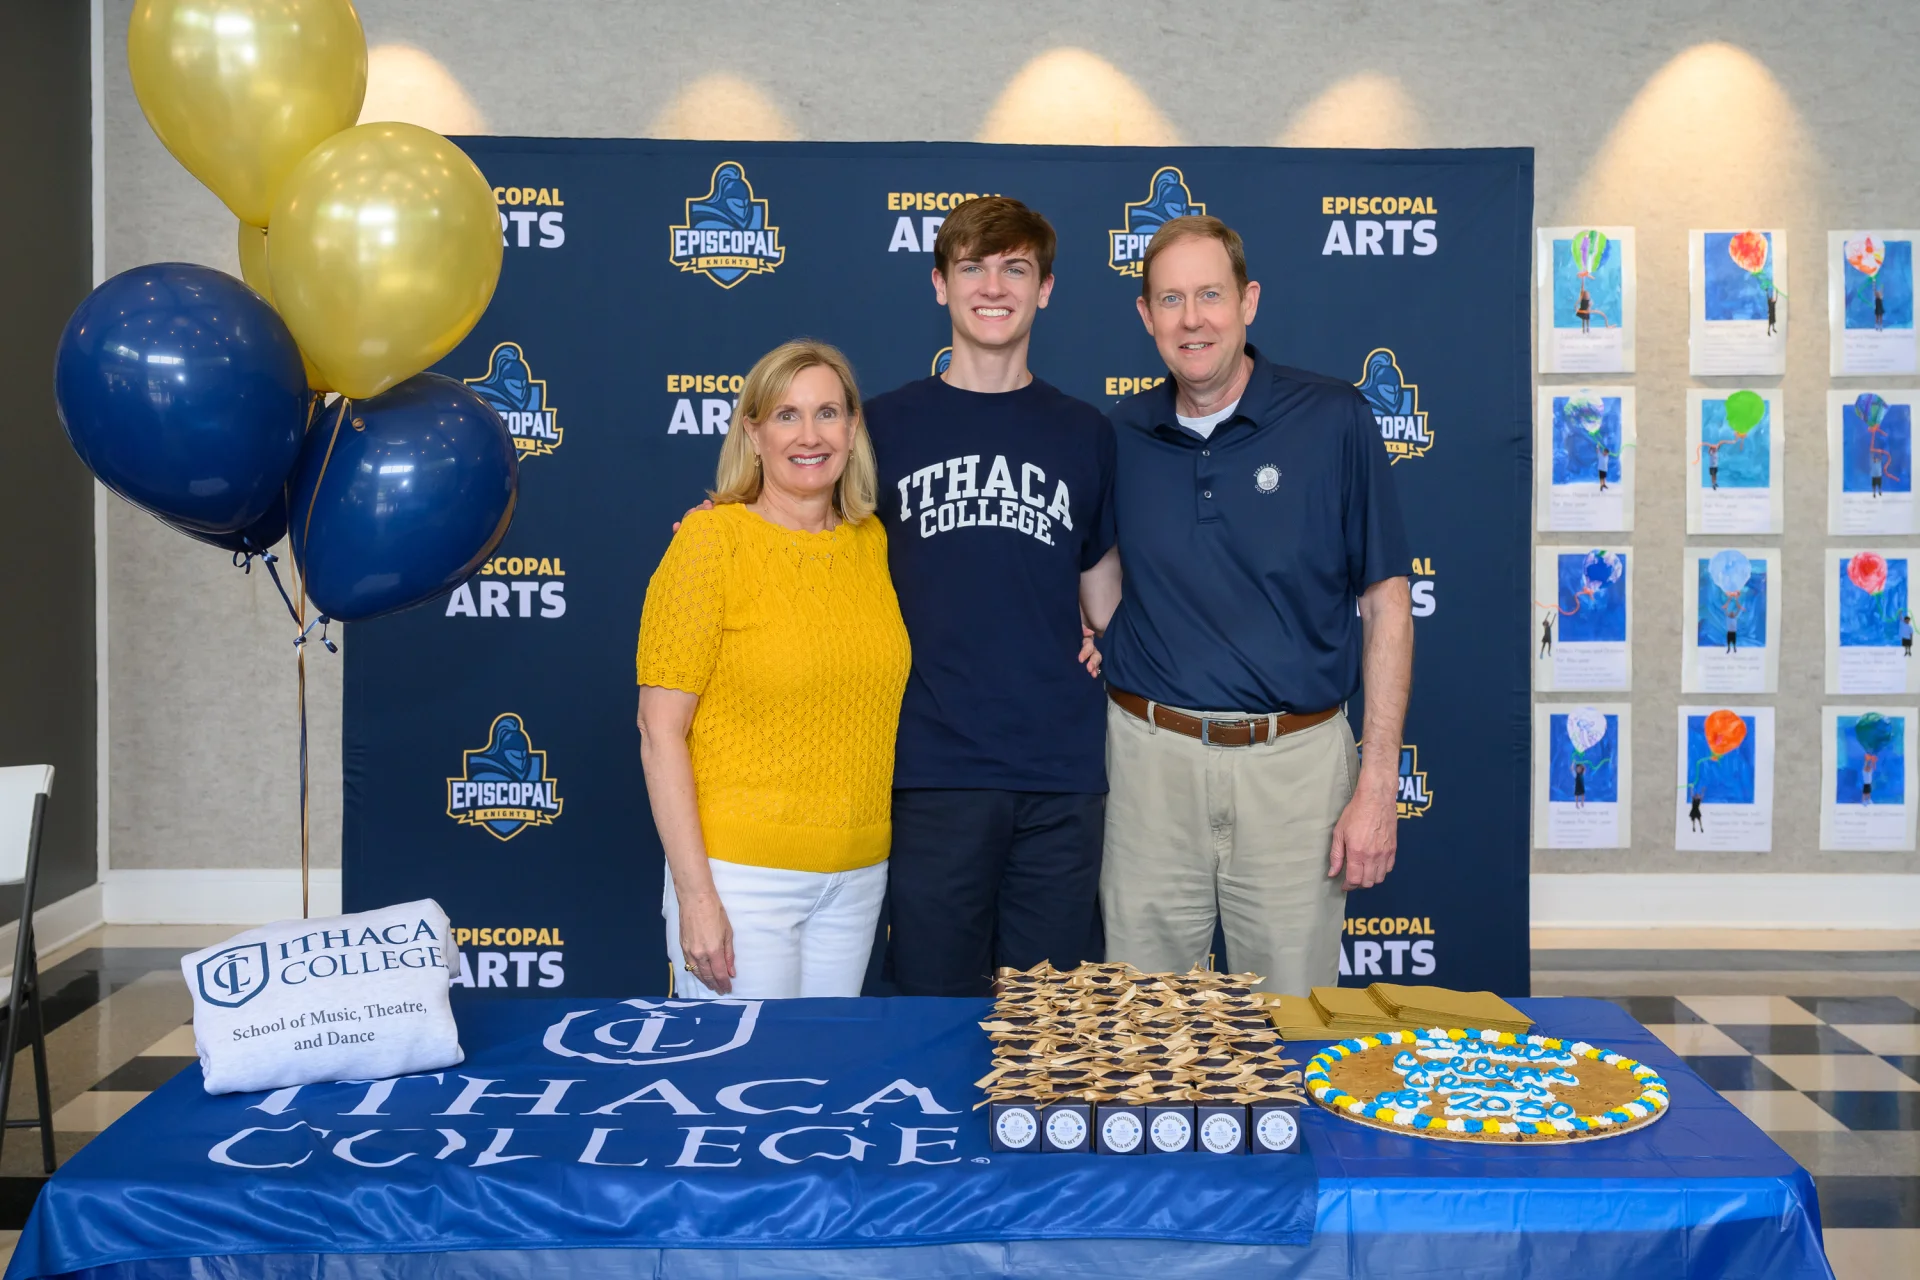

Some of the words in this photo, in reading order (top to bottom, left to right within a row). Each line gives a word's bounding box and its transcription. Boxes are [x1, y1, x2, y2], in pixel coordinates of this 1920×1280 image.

[492, 186, 564, 206] COPAL
[888, 192, 1001, 211] EPISCO
[1322, 197, 1438, 214] EPISCOPAL
[500, 211, 565, 248] TS
[1322, 220, 1438, 255] ARTS
[675, 230, 780, 258] EPISCOPAL
[667, 375, 745, 393] EPISCO
[667, 398, 739, 434] AR
[898, 455, 1073, 531] ITHACA
[476, 557, 565, 576] SCOPAL
[445, 581, 566, 618] ARTS
[452, 782, 559, 810] EPISCOPAL
[1342, 917, 1435, 935] ISCOPAL
[278, 919, 439, 960] ITHACA
[449, 951, 565, 988] ARTS
[233, 1017, 286, 1041] School
[290, 1014, 306, 1028] of
[310, 1007, 361, 1026] Music,
[364, 1001, 427, 1019] Theatre,
[294, 1033, 323, 1051] and
[327, 1031, 375, 1046] Dance
[245, 1073, 963, 1116] ITHACA
[1449, 1093, 1574, 1120] 2030
[1000, 1130, 1017, 1144] ITHACA
[1050, 1131, 1066, 1145] ITHACA
[1107, 1134, 1123, 1148] ITHACA
[1123, 1140, 1132, 1148] MT
[1154, 1135, 1172, 1147] ITHACA
[1172, 1139, 1180, 1147] MT
[1205, 1137, 1224, 1150] ITHACA
[1223, 1141, 1232, 1149] MT
[1261, 1133, 1278, 1146] ITHACA
